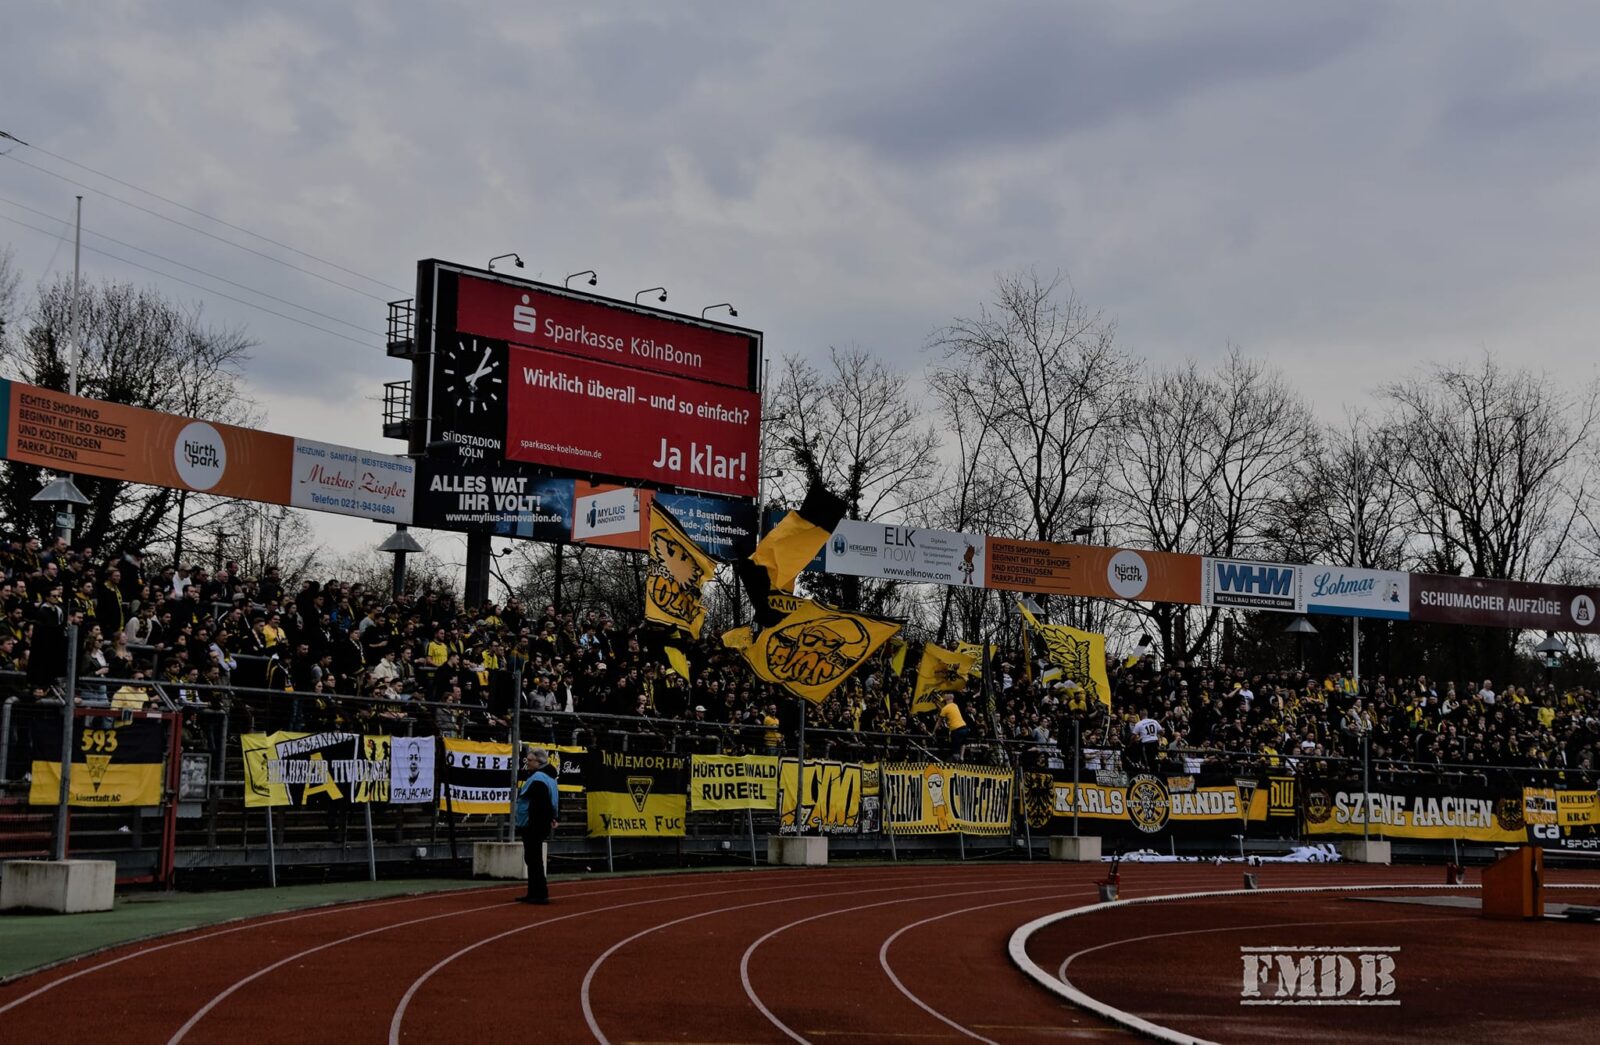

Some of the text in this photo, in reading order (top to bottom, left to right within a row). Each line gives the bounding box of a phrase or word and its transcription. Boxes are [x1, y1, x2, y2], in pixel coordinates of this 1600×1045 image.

[544, 319, 702, 368] Sparkasse KölnBonn
[523, 367, 750, 425] Wirklich überall und so einfach?
[20, 393, 99, 420] ECHTES SHOPPING
[19, 408, 126, 439] BEGINNT MIT 150 SHOPS
[18, 424, 101, 450] UND KOSTENLOSEN
[442, 430, 500, 450] SÜDSTADION
[184, 440, 216, 461] hürth
[458, 445, 484, 459] KÖLN
[520, 439, 602, 459] sparkasse-koelnbonn.de
[191, 453, 219, 468] park
[297, 446, 325, 457] HEIZUNG
[362, 458, 413, 473] MEISTERBETRIEB
[653, 437, 747, 481] Ja klar!
[300, 464, 407, 499] Markus Ziegler
[429, 474, 528, 494] ALLES WAT
[311, 493, 339, 506] Telefon
[458, 494, 541, 512] IHR VOLT!
[445, 512, 562, 524] www.mylius-innovation.de
[597, 505, 626, 518] MYLIUS
[597, 515, 626, 524] INNOVATION
[696, 510, 732, 523] Baustrom
[884, 526, 916, 547] ELK
[849, 544, 878, 553] HERGARTEN
[883, 546, 917, 562] now
[992, 543, 1050, 556] ECHTES SHOPPING
[991, 563, 1053, 576] UND KOSTENLOSEN
[992, 554, 1019, 562] BEGINNT
[1020, 556, 1031, 564] MIT
[1046, 559, 1071, 567] SHOPS
[1114, 564, 1139, 575] hürth
[883, 567, 952, 580] www.elknow.com
[1120, 571, 1143, 583] park
[1216, 563, 1293, 596] WHM
[1311, 572, 1378, 598] Lohmar
[1216, 595, 1249, 604] METALLBAU
[1249, 598, 1276, 606] HECKNER
[1420, 590, 1562, 616] SCHUMACHER AUFZÜGE
[1145, 724, 1155, 735] 10
[80, 728, 118, 753] 593
[600, 749, 612, 767] IN
[112, 793, 121, 802] AC
[1055, 787, 1238, 815] KARLS BANDE
[1335, 791, 1493, 828] SZENE AACHEN
